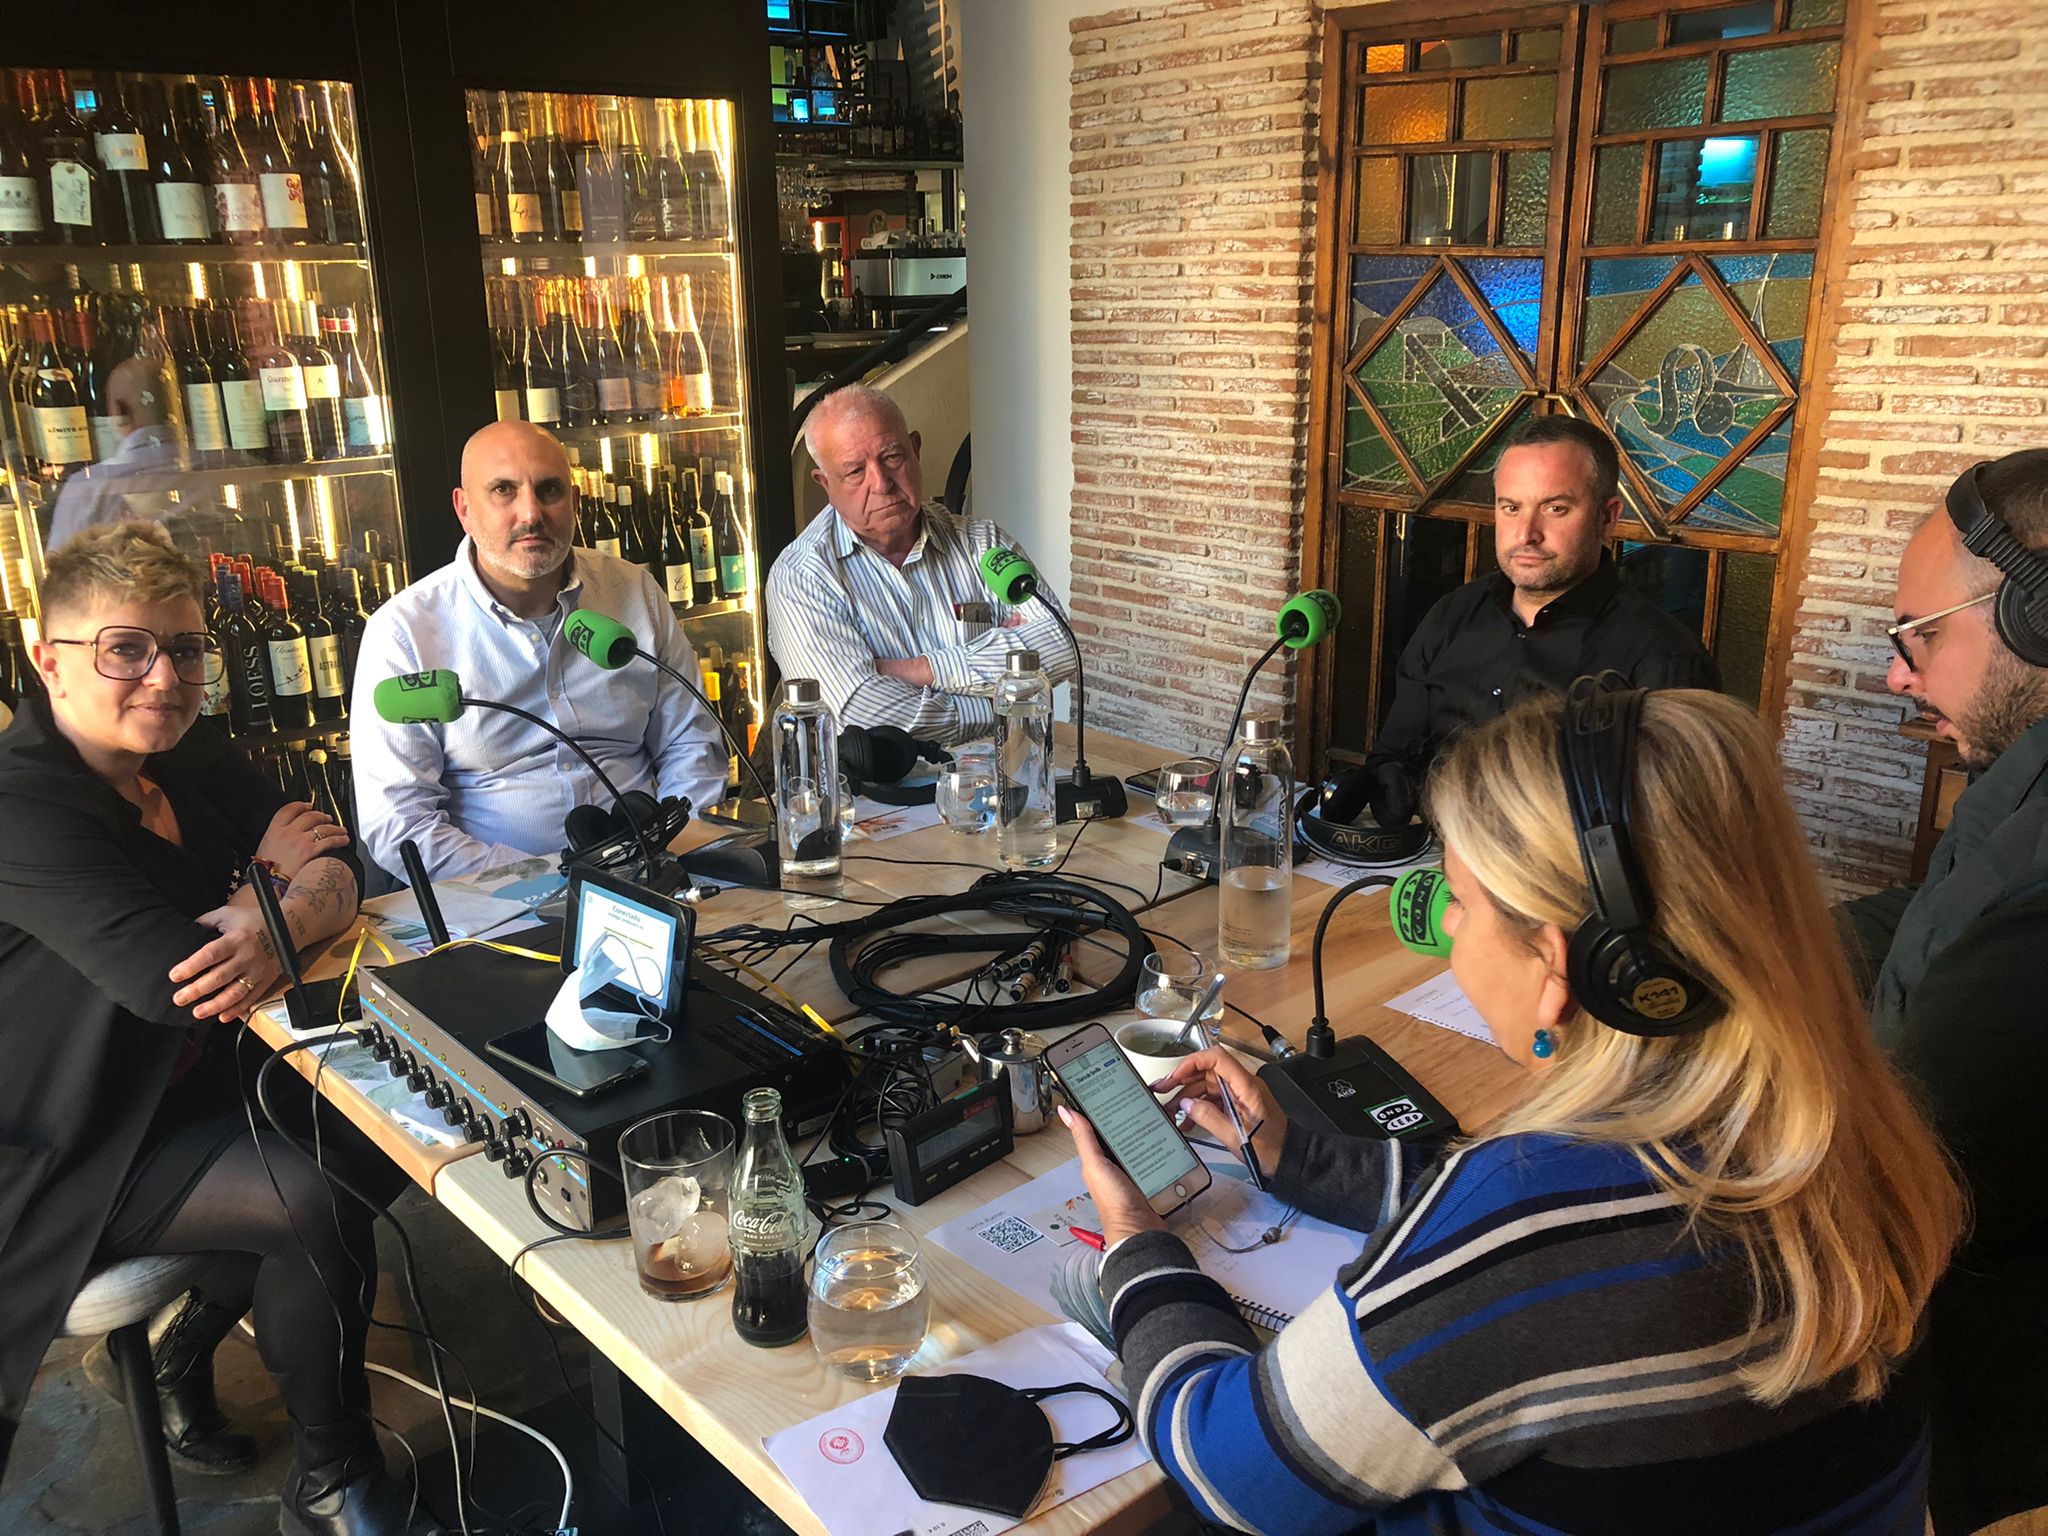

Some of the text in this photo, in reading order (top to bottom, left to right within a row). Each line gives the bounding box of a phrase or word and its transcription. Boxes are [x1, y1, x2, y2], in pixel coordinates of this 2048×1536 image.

[243, 645, 269, 711] LOESS
[1329, 831, 1402, 854] AKG
[1401, 879, 1418, 932] CERO
[1414, 878, 1433, 934] ONDA
[1337, 1088, 1357, 1098] AKG
[1378, 1104, 1410, 1120] ONDA
[1391, 1114, 1419, 1128] CERO
[733, 1208, 794, 1234] Coca-Col
